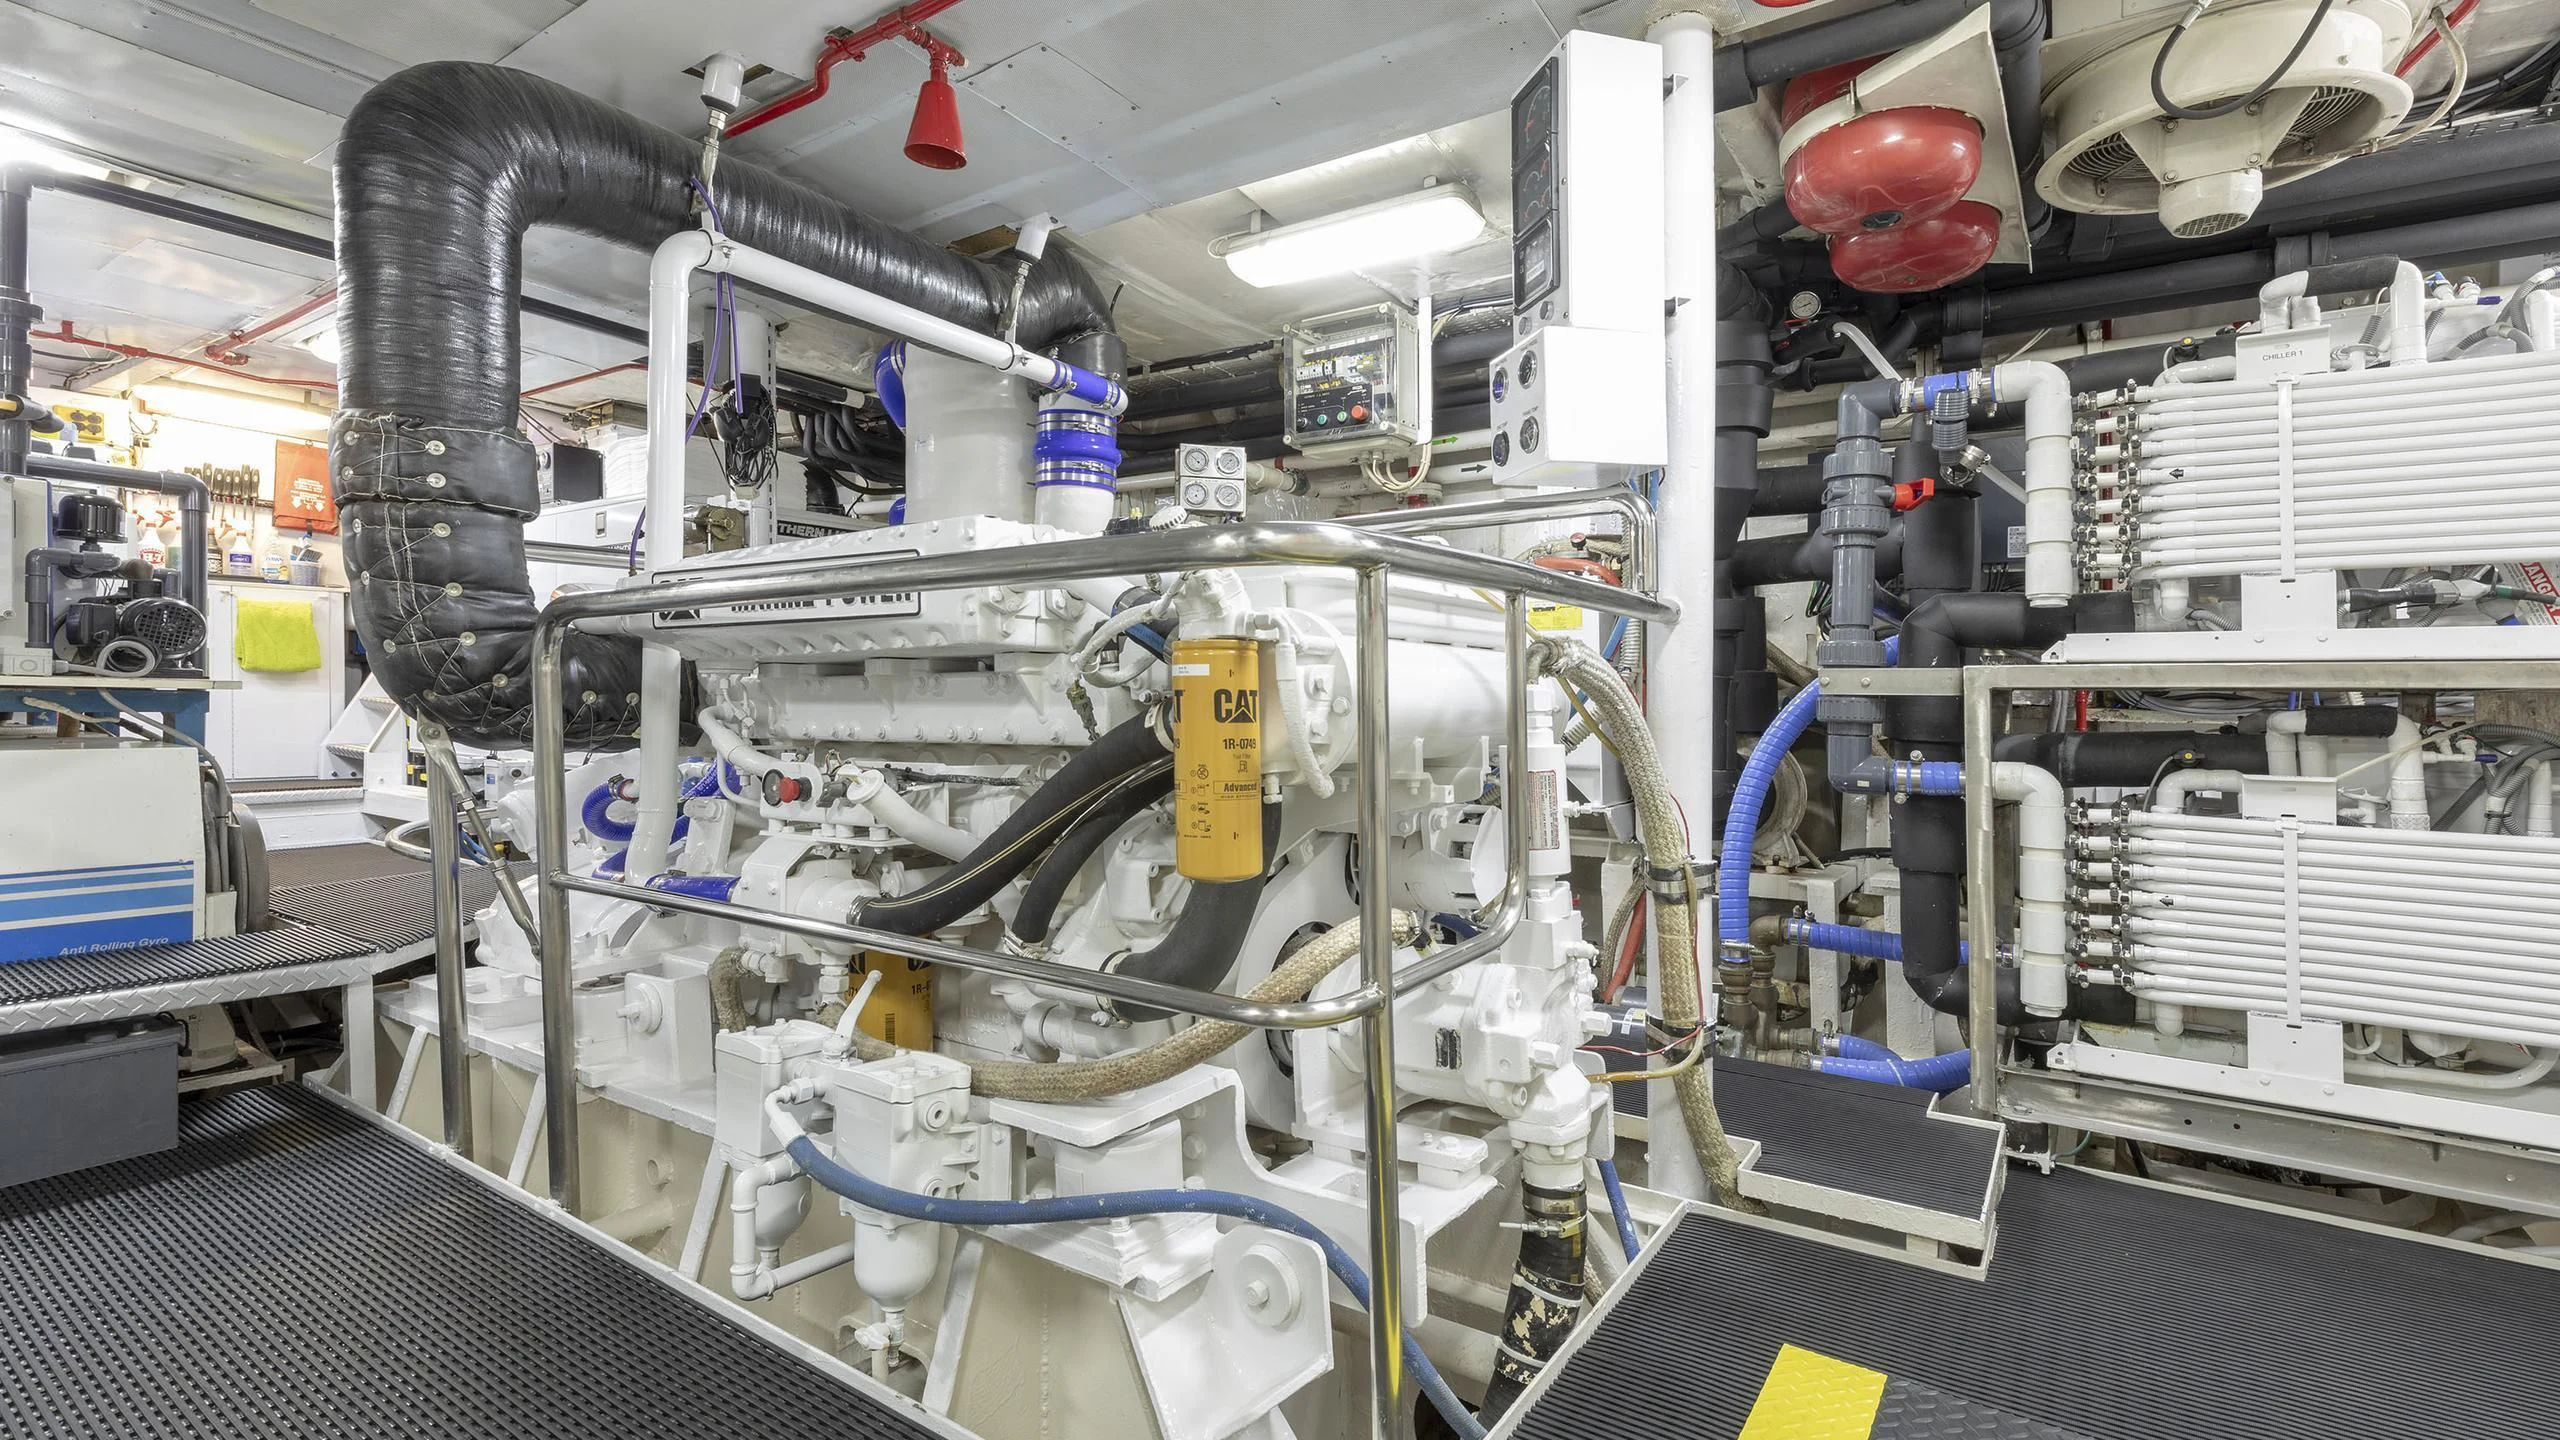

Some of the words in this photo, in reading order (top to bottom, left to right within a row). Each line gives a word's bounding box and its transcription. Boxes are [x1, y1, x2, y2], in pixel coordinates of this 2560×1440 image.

[2262, 350, 2297, 361] CHILLER
[1213, 688, 1258, 723] CAT
[1222, 738, 1257, 750] 1R-0749
[59, 944, 87, 956] Anti
[90, 941, 136, 953] Rolling
[139, 937, 169, 948] Gyro
